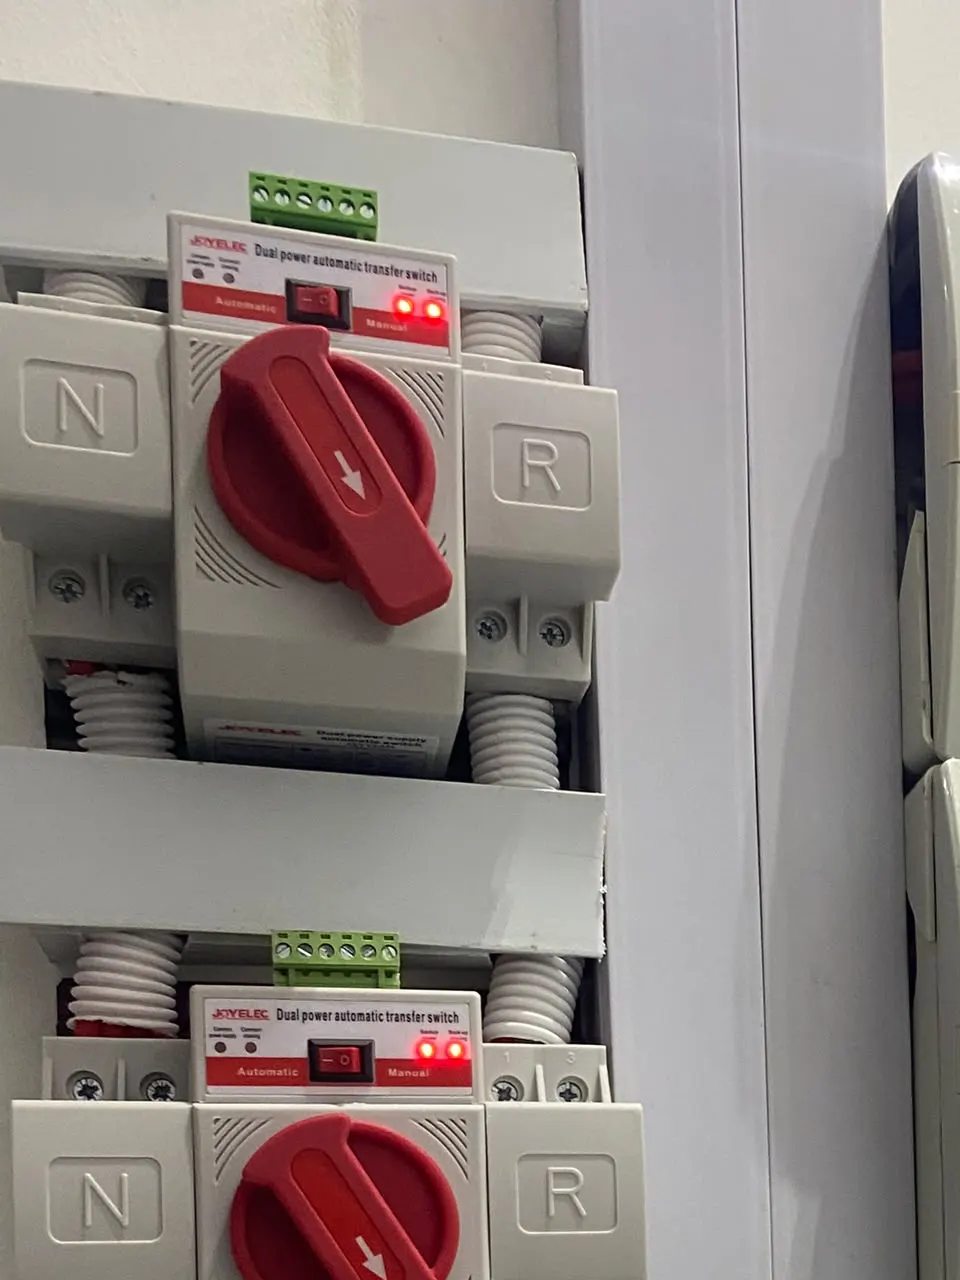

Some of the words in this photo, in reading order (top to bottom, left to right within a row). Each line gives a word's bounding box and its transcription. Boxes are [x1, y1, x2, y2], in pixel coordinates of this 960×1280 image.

[190, 235, 247, 254] JOYELEC
[254, 243, 278, 259] Dual
[280, 249, 311, 265] power
[313, 254, 363, 273] automatic
[364, 262, 405, 279] transfer
[405, 268, 438, 283] switch
[215, 296, 277, 314] Automatic
[365, 317, 408, 332] Manual
[56, 377, 104, 438] N
[521, 438, 561, 492] R
[212, 1008, 270, 1020] JOYELEC
[276, 1007, 300, 1021] Dual
[302, 1010, 332, 1023] power
[334, 1010, 384, 1022] automatic
[386, 1010, 425, 1023] transfer
[427, 1011, 459, 1024] switch
[236, 1066, 300, 1077] Automatic
[388, 1067, 429, 1078] Manual
[83, 1172, 129, 1228] N
[546, 1166, 587, 1217] R
